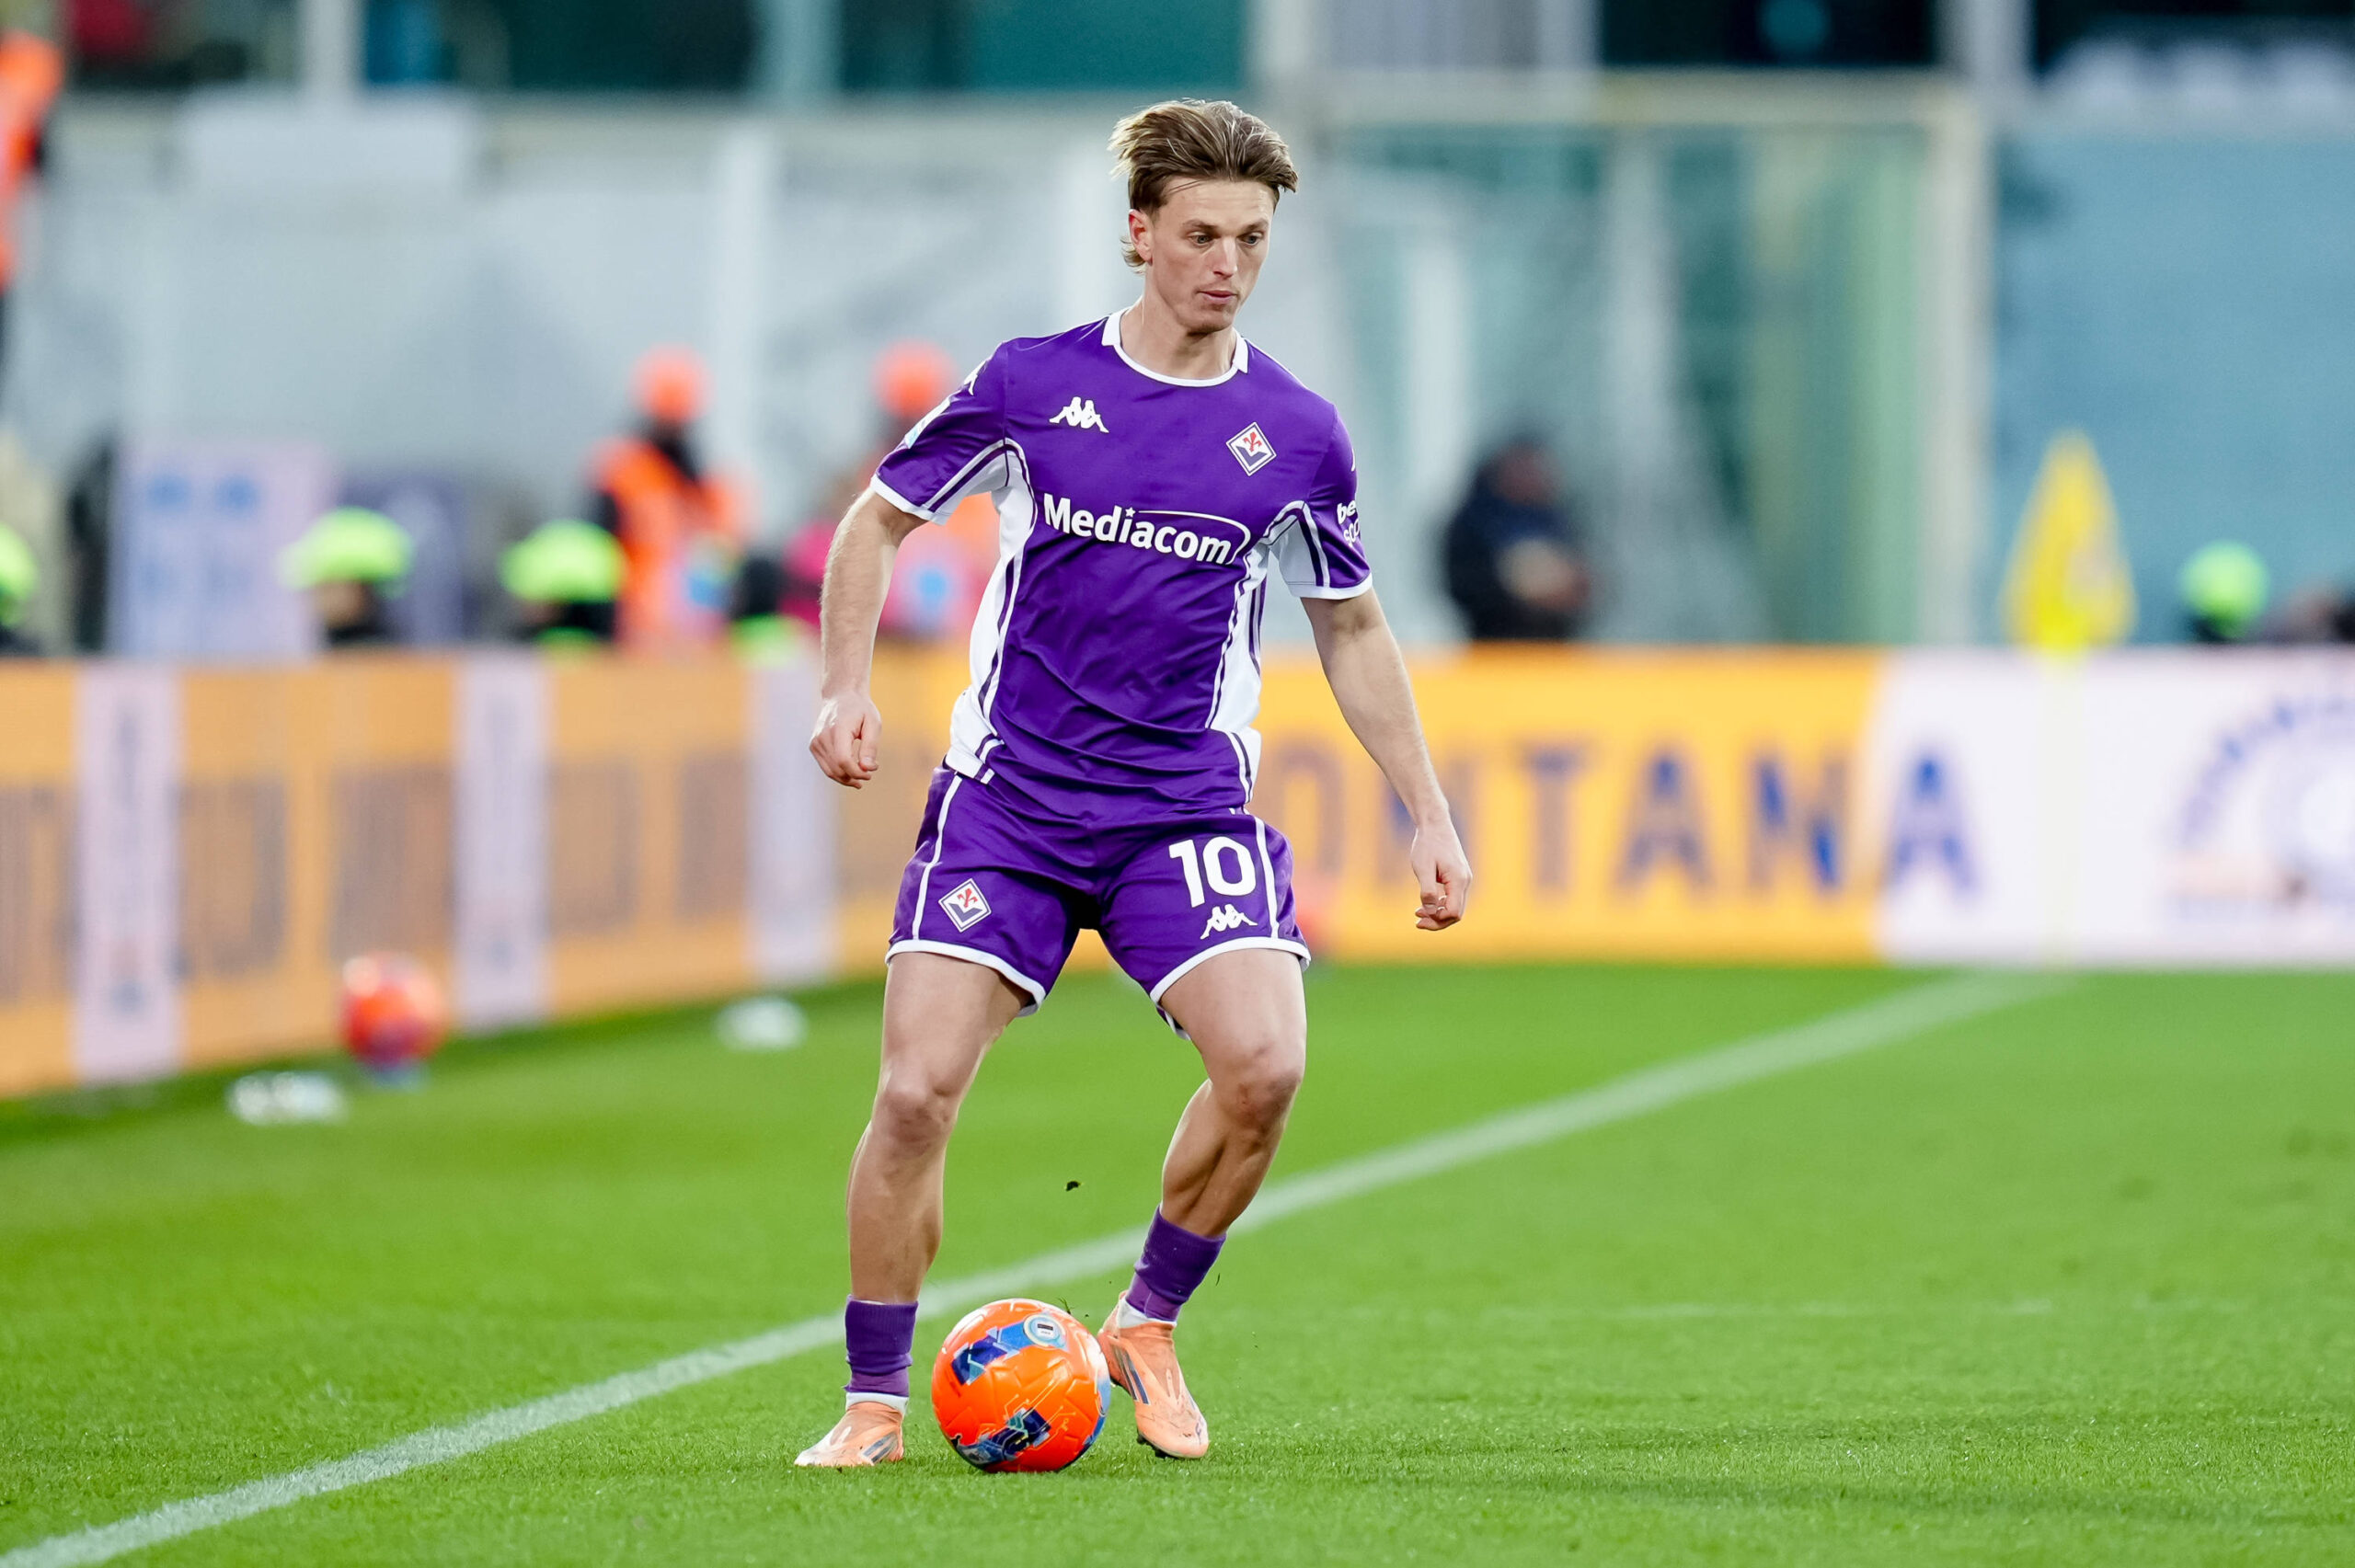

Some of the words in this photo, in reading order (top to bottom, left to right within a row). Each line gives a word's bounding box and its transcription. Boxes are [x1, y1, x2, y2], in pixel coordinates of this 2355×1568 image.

[1043, 492, 1232, 565] Mediacom
[1253, 736, 1983, 894] ONTANA
[1168, 836, 1257, 908] 10
